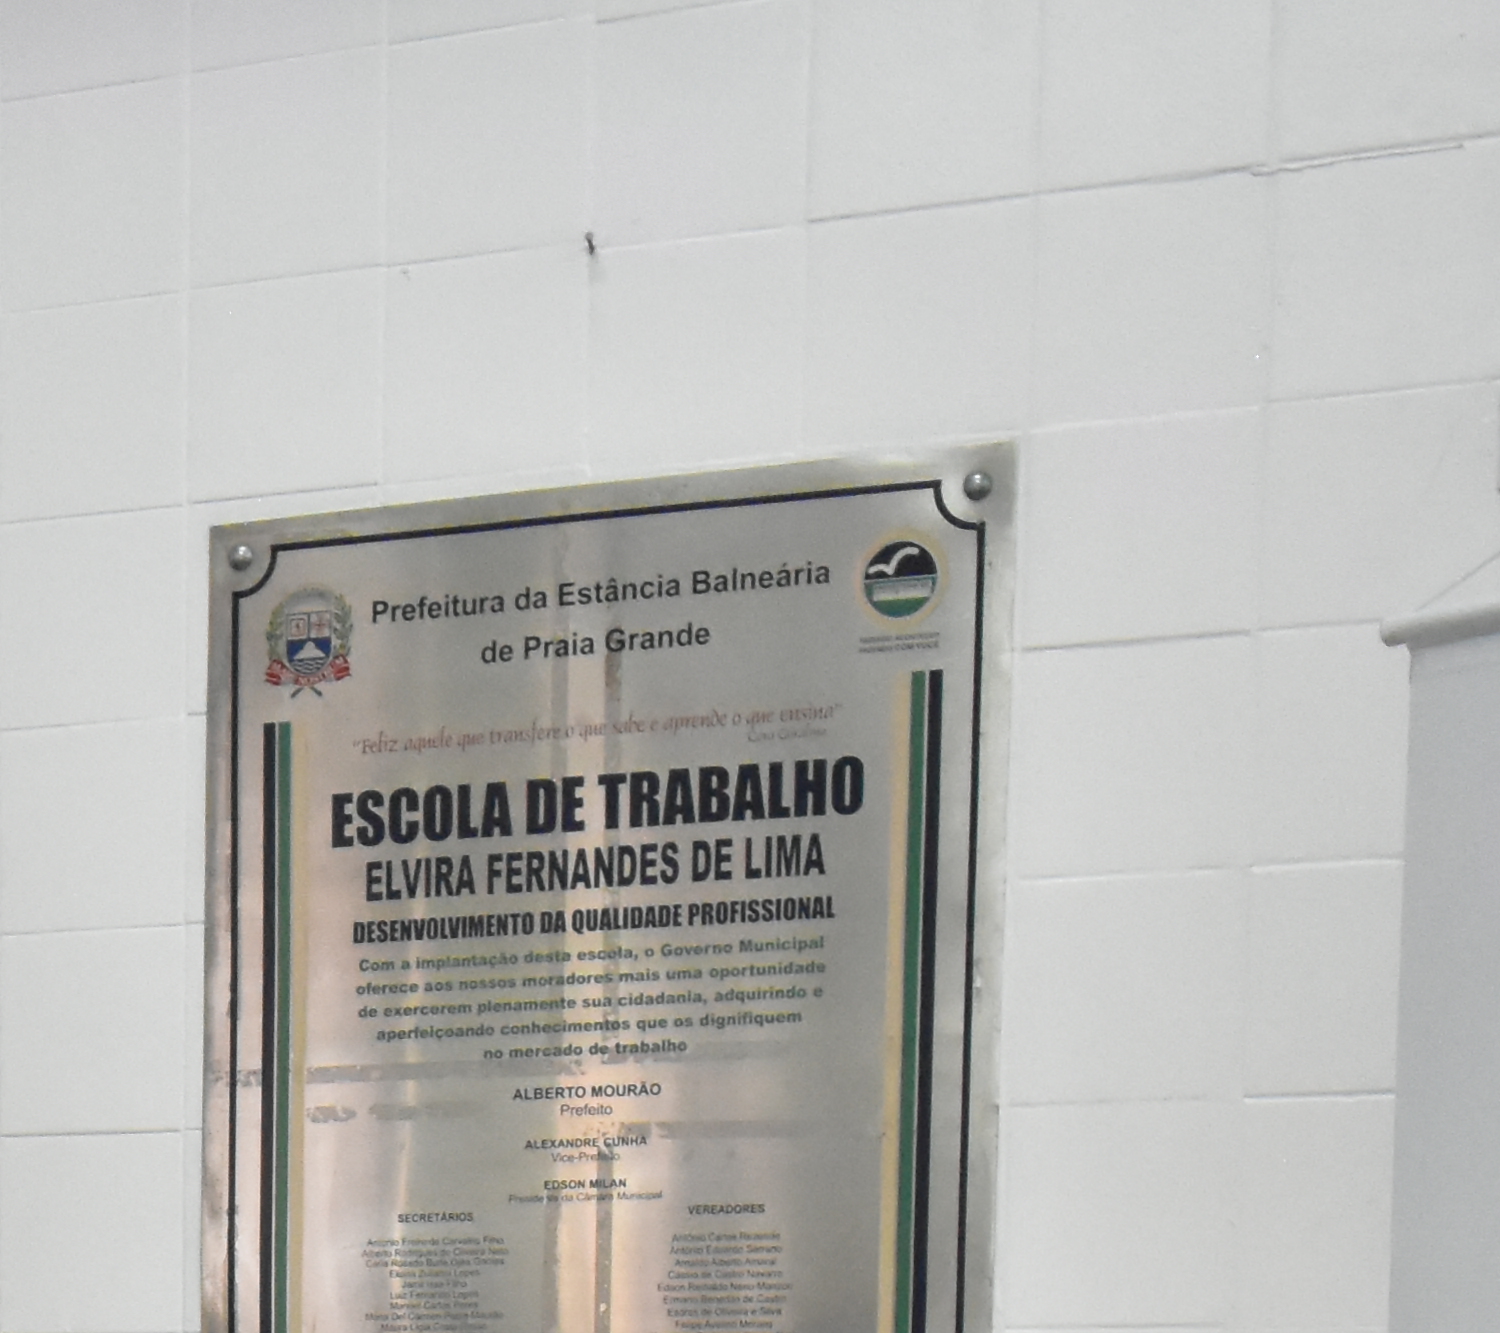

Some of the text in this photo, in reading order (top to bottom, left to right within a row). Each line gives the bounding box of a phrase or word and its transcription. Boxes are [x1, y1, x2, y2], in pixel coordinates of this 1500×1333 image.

[371, 559, 832, 625] Prefeitura da Estância Balneária
[480, 622, 711, 665] de Praia Grande
[331, 755, 866, 848] ESCOLA DE TRABALHO
[365, 833, 826, 903] ELVIRA FERNANDES DE LIMA
[352, 895, 836, 945] DESENVOLVIMENTO DA QUALIDADE PROFISSIONAL
[358, 935, 825, 973] Com a implantação desta escola, o Governo Municipal
[356, 959, 827, 996] oferece aos nossos moradores mais uma oportunidade
[358, 1004, 378, 1018] de
[477, 996, 577, 1016] plenamente
[582, 997, 613, 1009] sua
[713, 984, 808, 1007] adquirindo
[813, 987, 824, 998] e
[376, 1008, 803, 1043] aperfeiçoando conhecimentos que os dignifiquem
[483, 1038, 689, 1061] no mercado de trabalho
[512, 1080, 662, 1101] ALBERTO MOURÃO
[559, 1102, 614, 1118] Prefeito
[524, 1134, 648, 1150] ALEXANDRE CUNHA
[543, 1177, 627, 1191] EDSON MILAN
[397, 1211, 474, 1224] SECRETÁRIOS
[687, 1203, 766, 1215] VEREADORES
